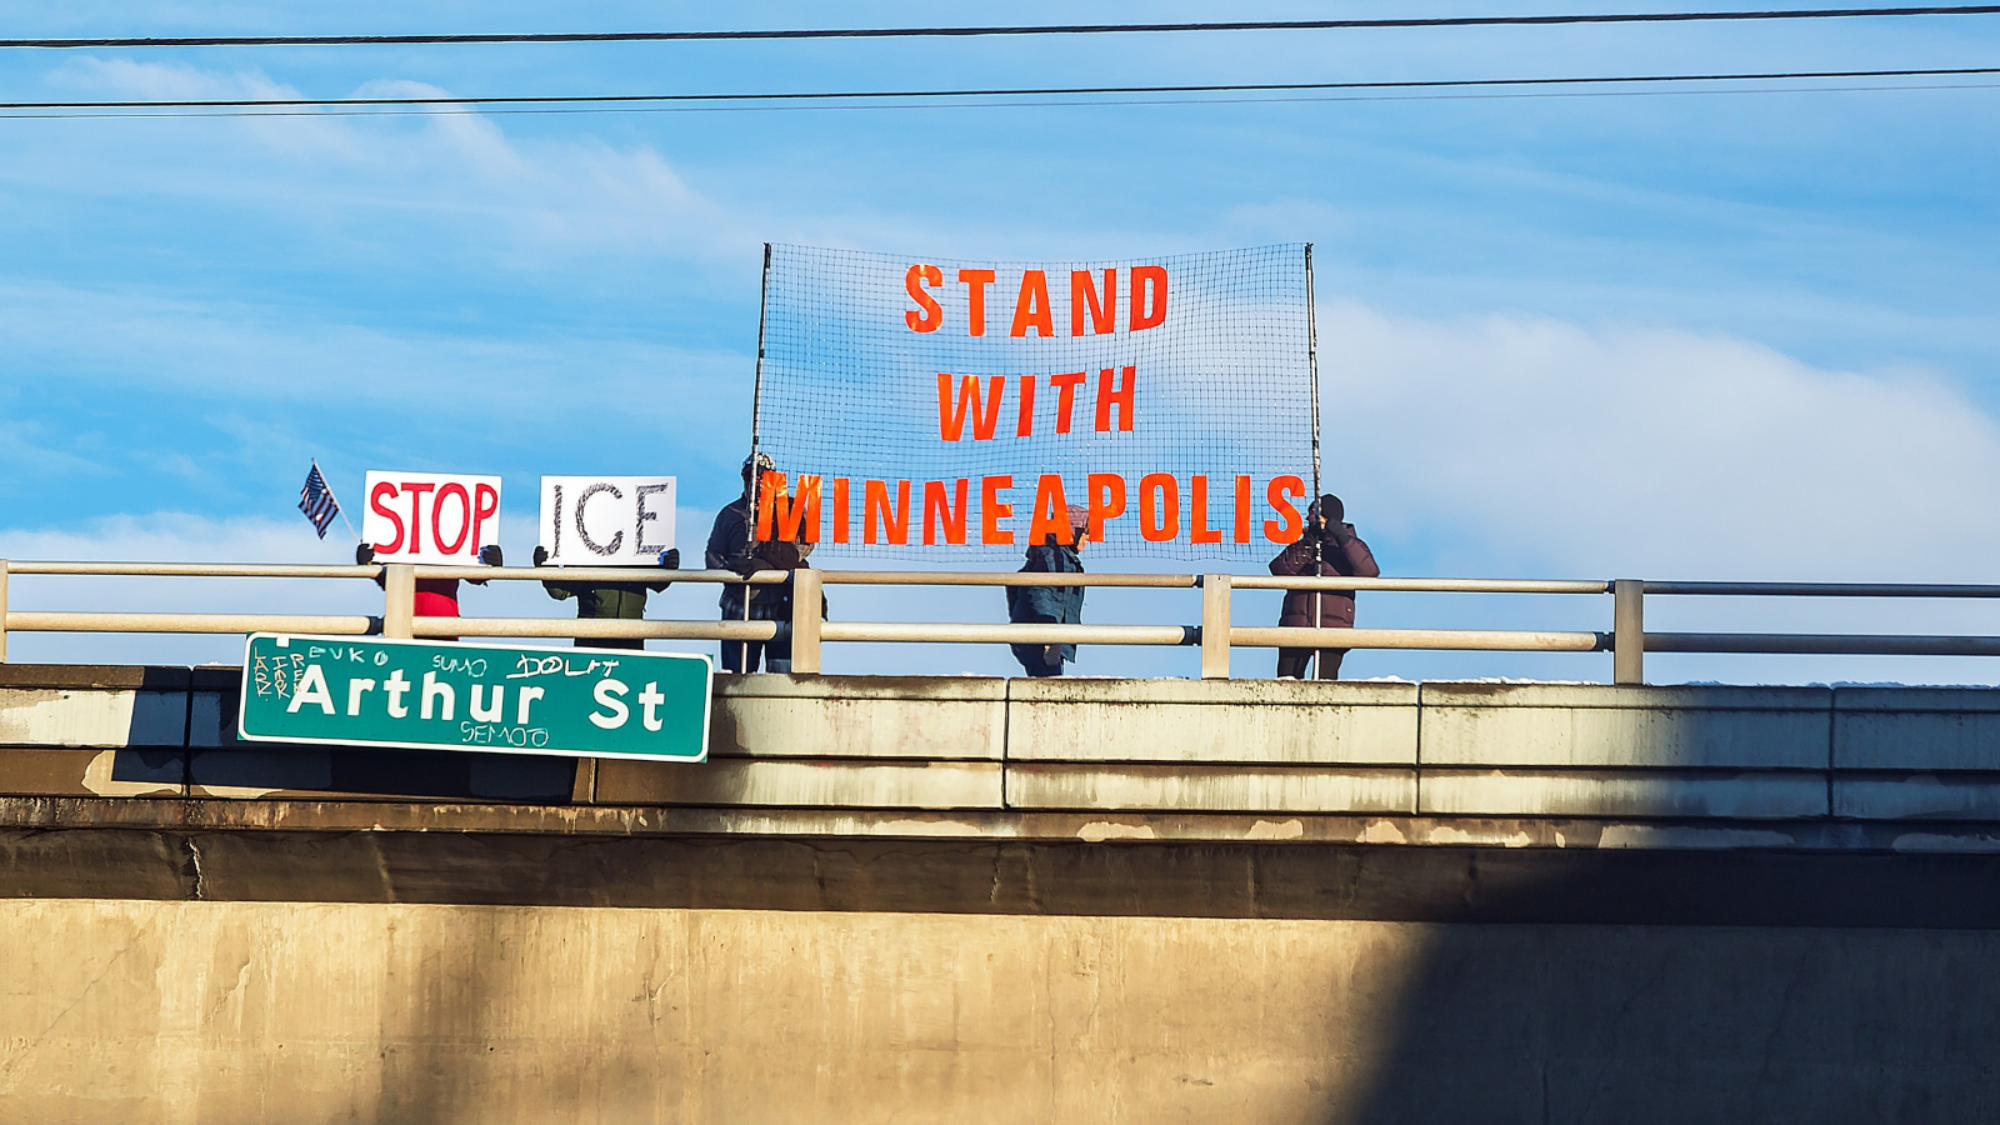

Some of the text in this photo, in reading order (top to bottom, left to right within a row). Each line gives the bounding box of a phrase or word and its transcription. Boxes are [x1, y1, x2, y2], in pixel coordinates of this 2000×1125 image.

[905, 264, 1168, 337] STAND
[937, 365, 1136, 442] WITH
[370, 481, 498, 555] STOP
[551, 482, 668, 559] ICE
[756, 470, 1306, 546] MINNEAPOLIS
[286, 664, 666, 732] Arthur St
[432, 654, 488, 678] SUMO
